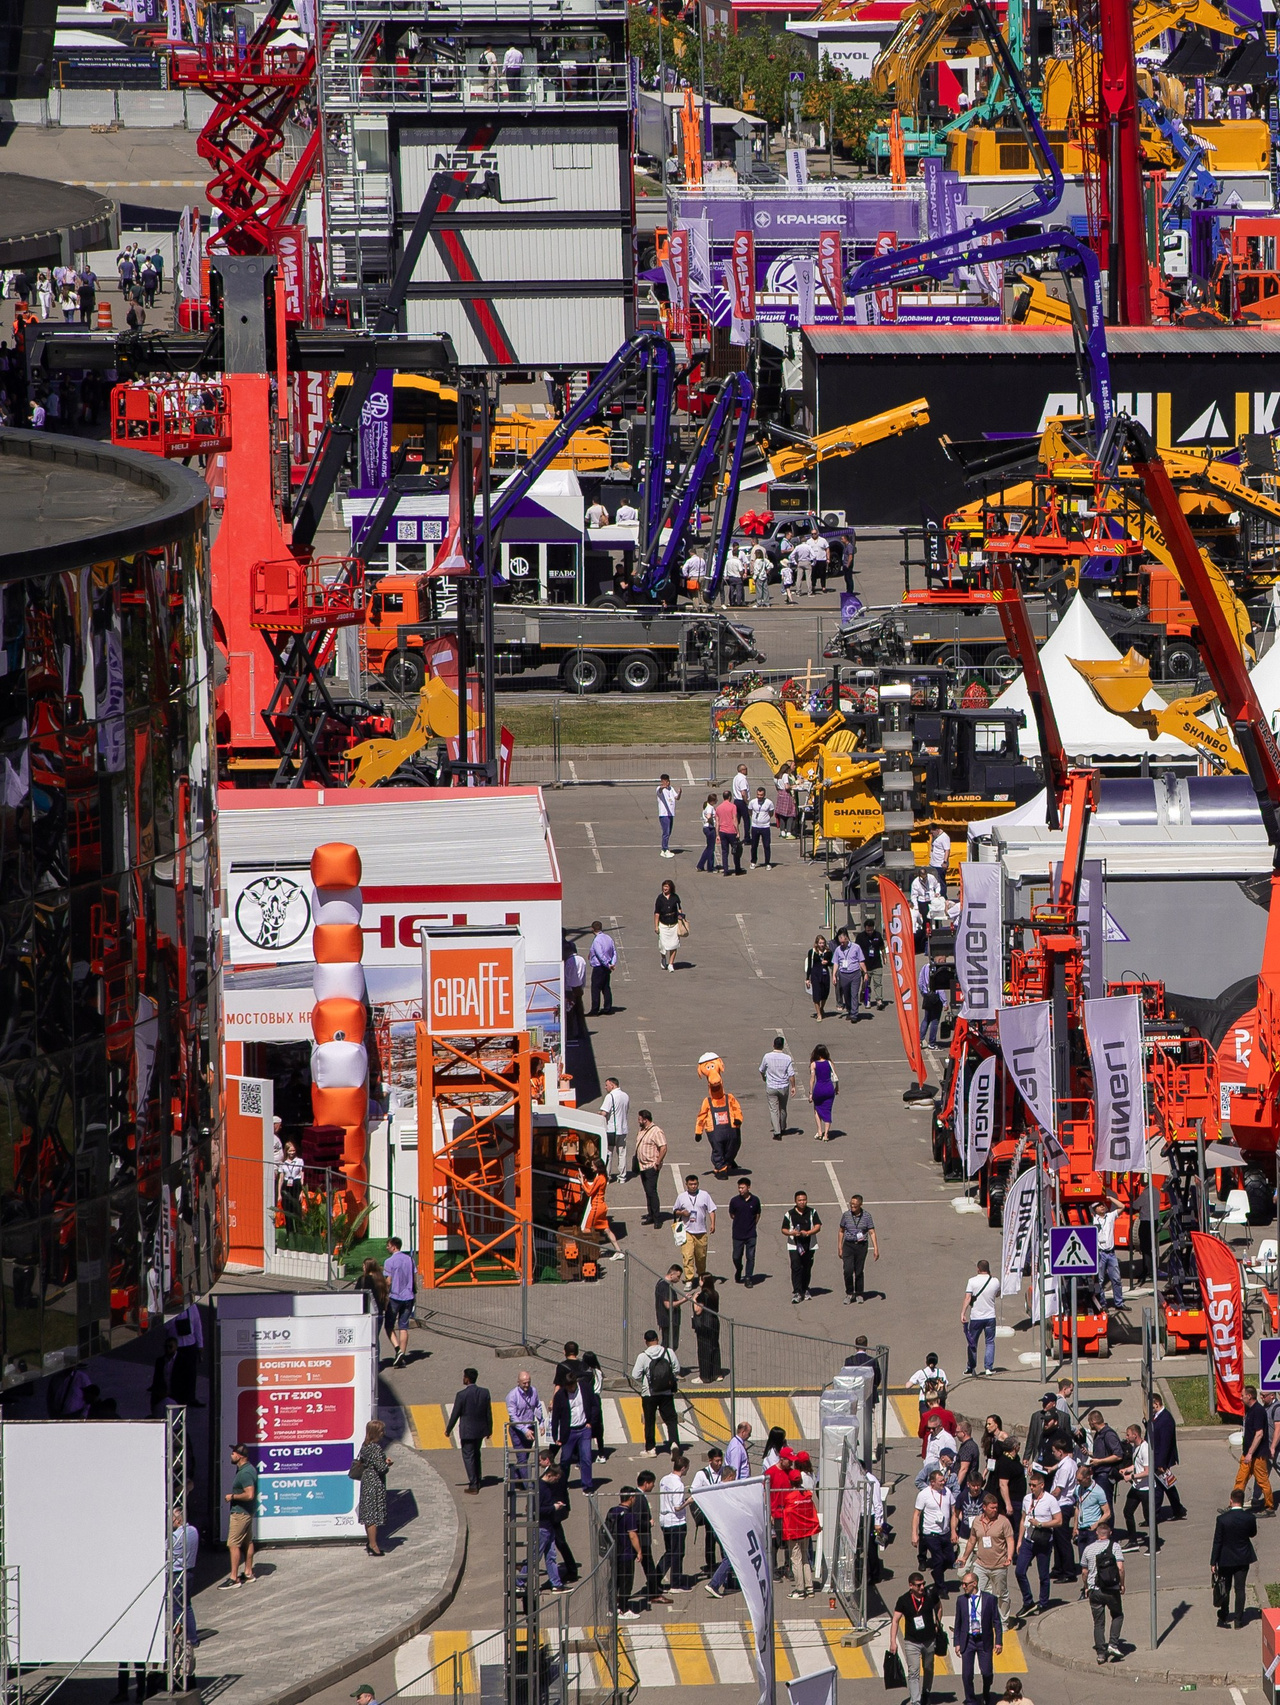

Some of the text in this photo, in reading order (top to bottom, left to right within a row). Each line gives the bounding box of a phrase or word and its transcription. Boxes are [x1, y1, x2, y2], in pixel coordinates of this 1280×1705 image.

[776, 214, 847, 225] КРАНЭКС
[953, 315, 1000, 324] спецтехники
[171, 442, 190, 451] HELI
[310, 617, 327, 625] HELI
[753, 725, 779, 766] SHANBO
[1200, 732, 1228, 753] ANBO
[833, 809, 883, 817] SHANBO
[434, 962, 511, 1028] GIRAFFE
[226, 1011, 294, 1026] МОСТОВЫХ
[975, 1075, 991, 1154] DINGLI
[1206, 1276, 1241, 1383] FIRST
[259, 1359, 332, 1370] LOGISTIKA EXPO
[274, 1373, 279, 1382] 1
[306, 1372, 311, 1381] 1
[270, 1390, 323, 1401] CTT EXPO
[274, 1405, 279, 1414] 1
[274, 1418, 281, 1427] 2
[269, 1446, 323, 1457] CTO EXPO
[274, 1462, 281, 1471] 2
[272, 1479, 318, 1489] COMVEX
[274, 1492, 279, 1501] 1
[306, 1491, 315, 1500] 4
[274, 1505, 281, 1514] 3
